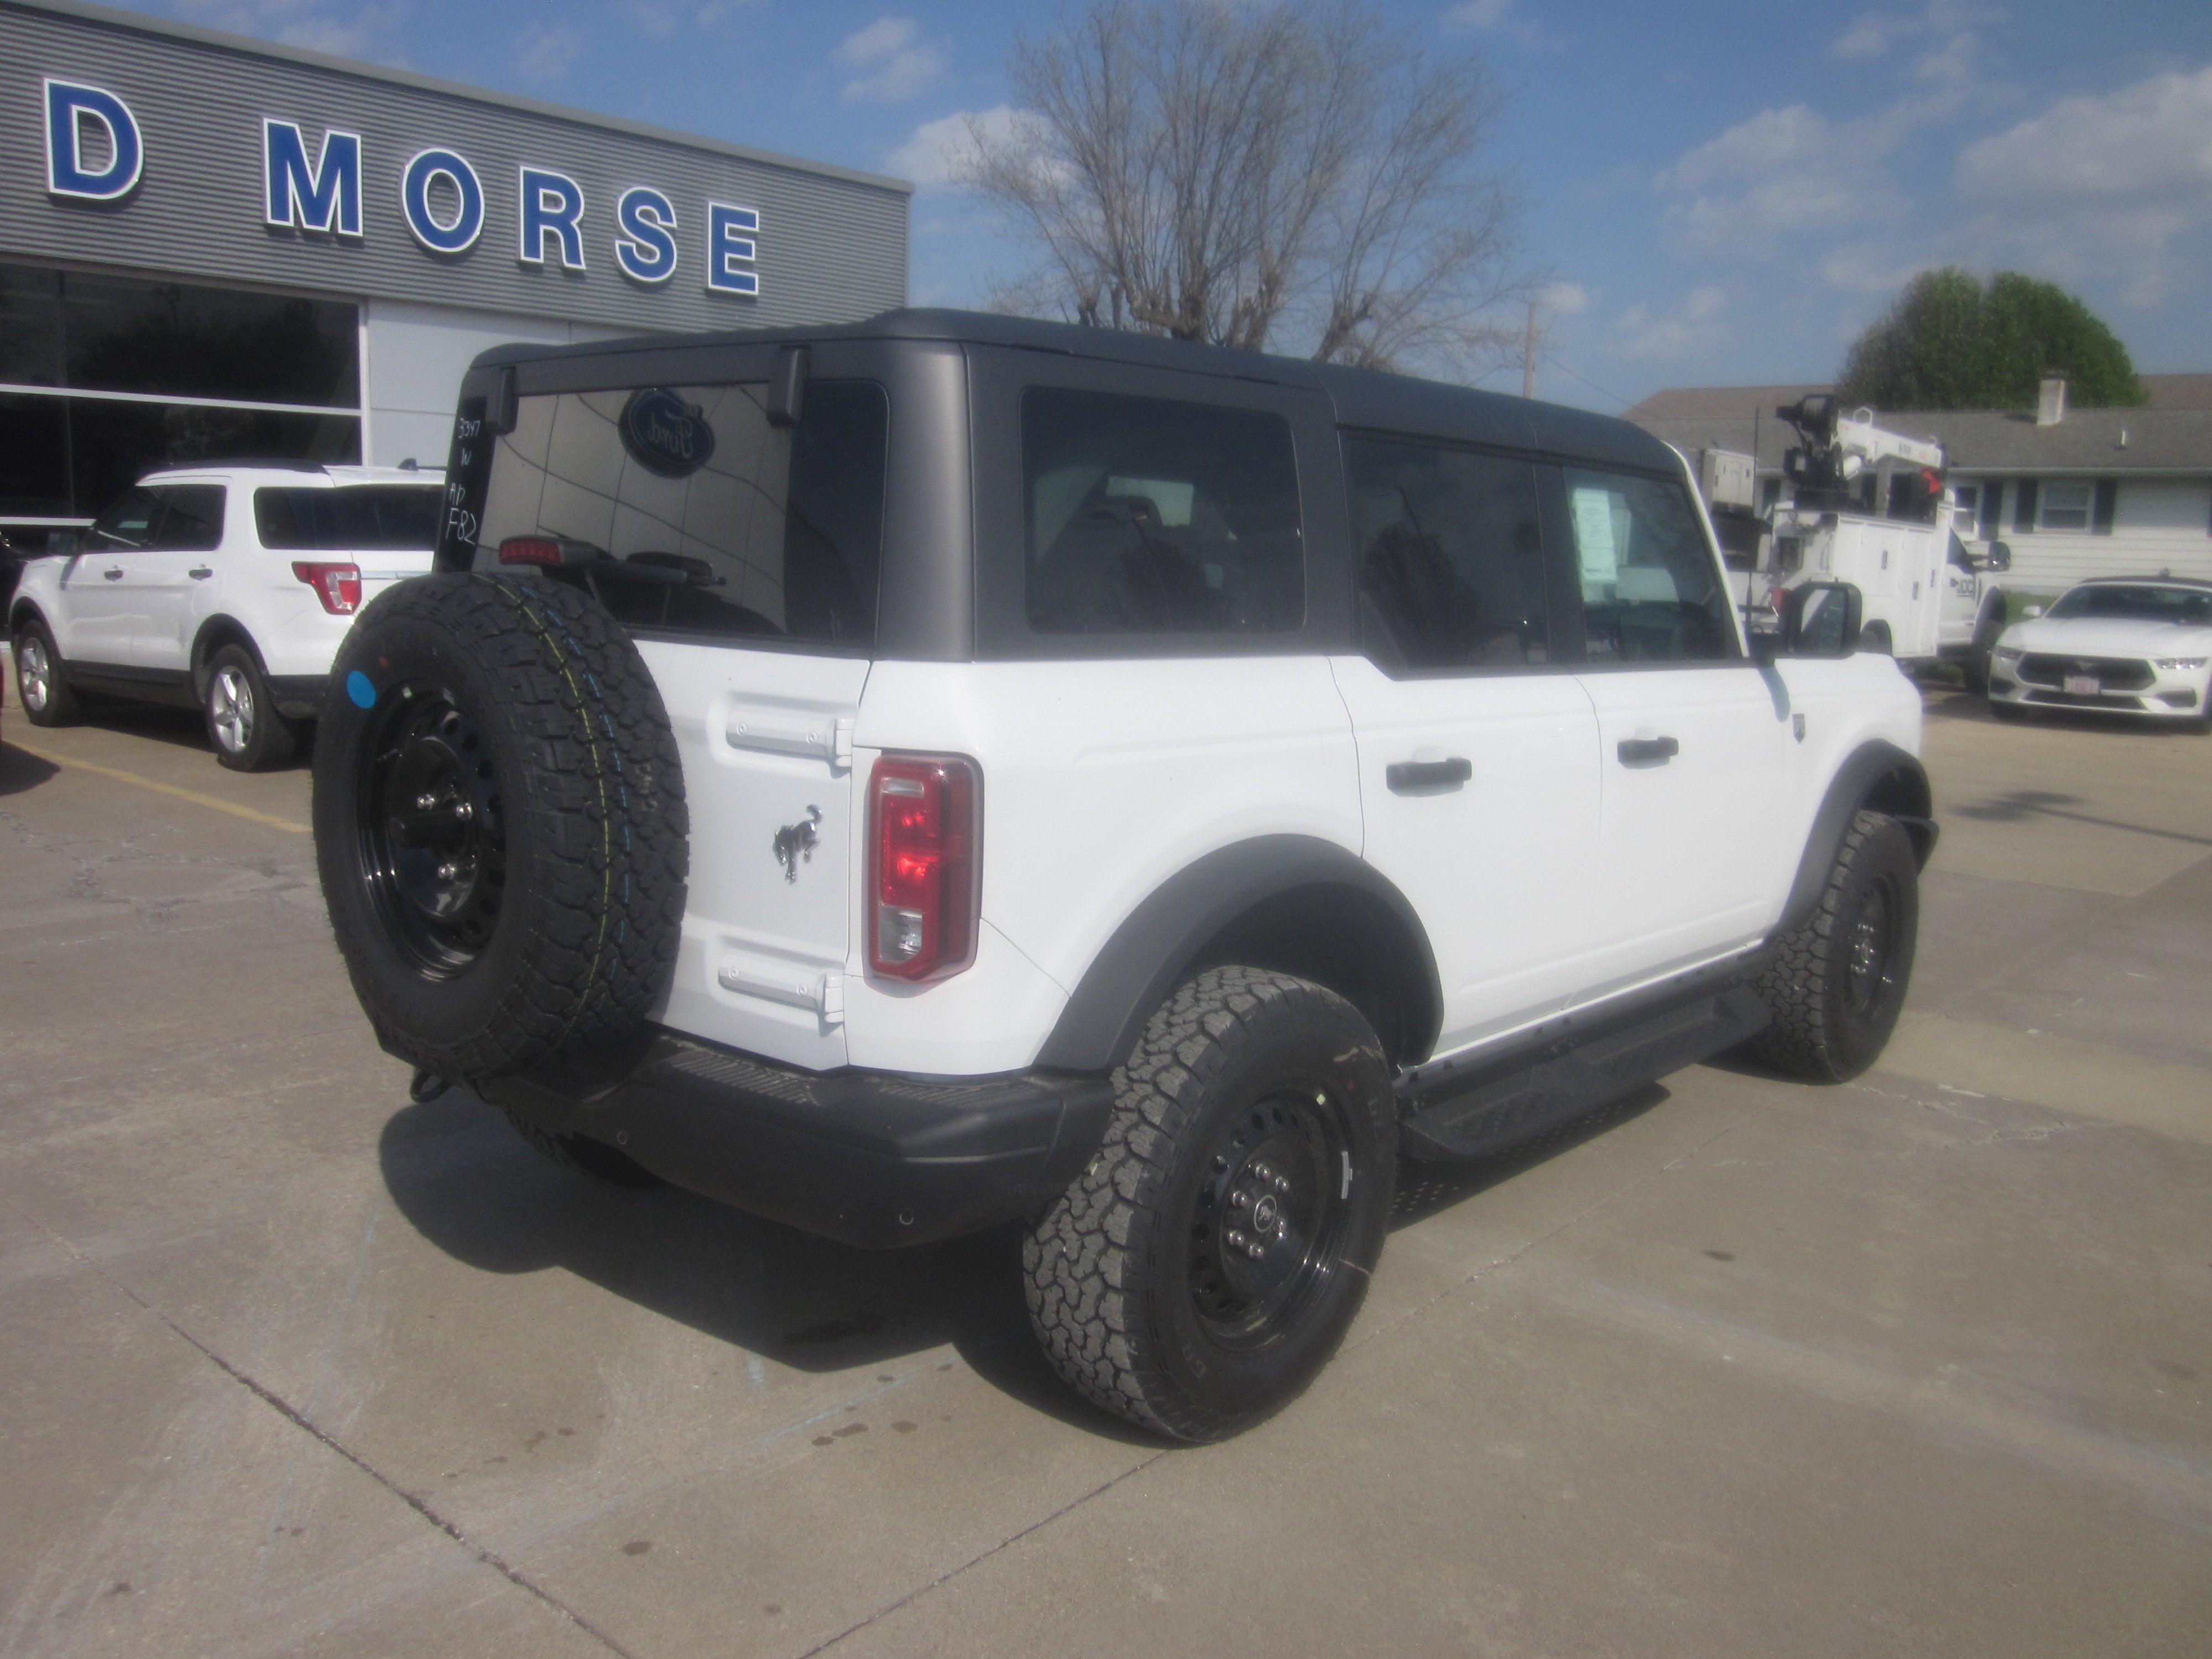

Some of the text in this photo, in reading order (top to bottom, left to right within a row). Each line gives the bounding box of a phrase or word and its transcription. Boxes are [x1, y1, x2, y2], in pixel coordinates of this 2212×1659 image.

[44, 77, 760, 295] D MORSE
[446, 508, 476, 545] F82
